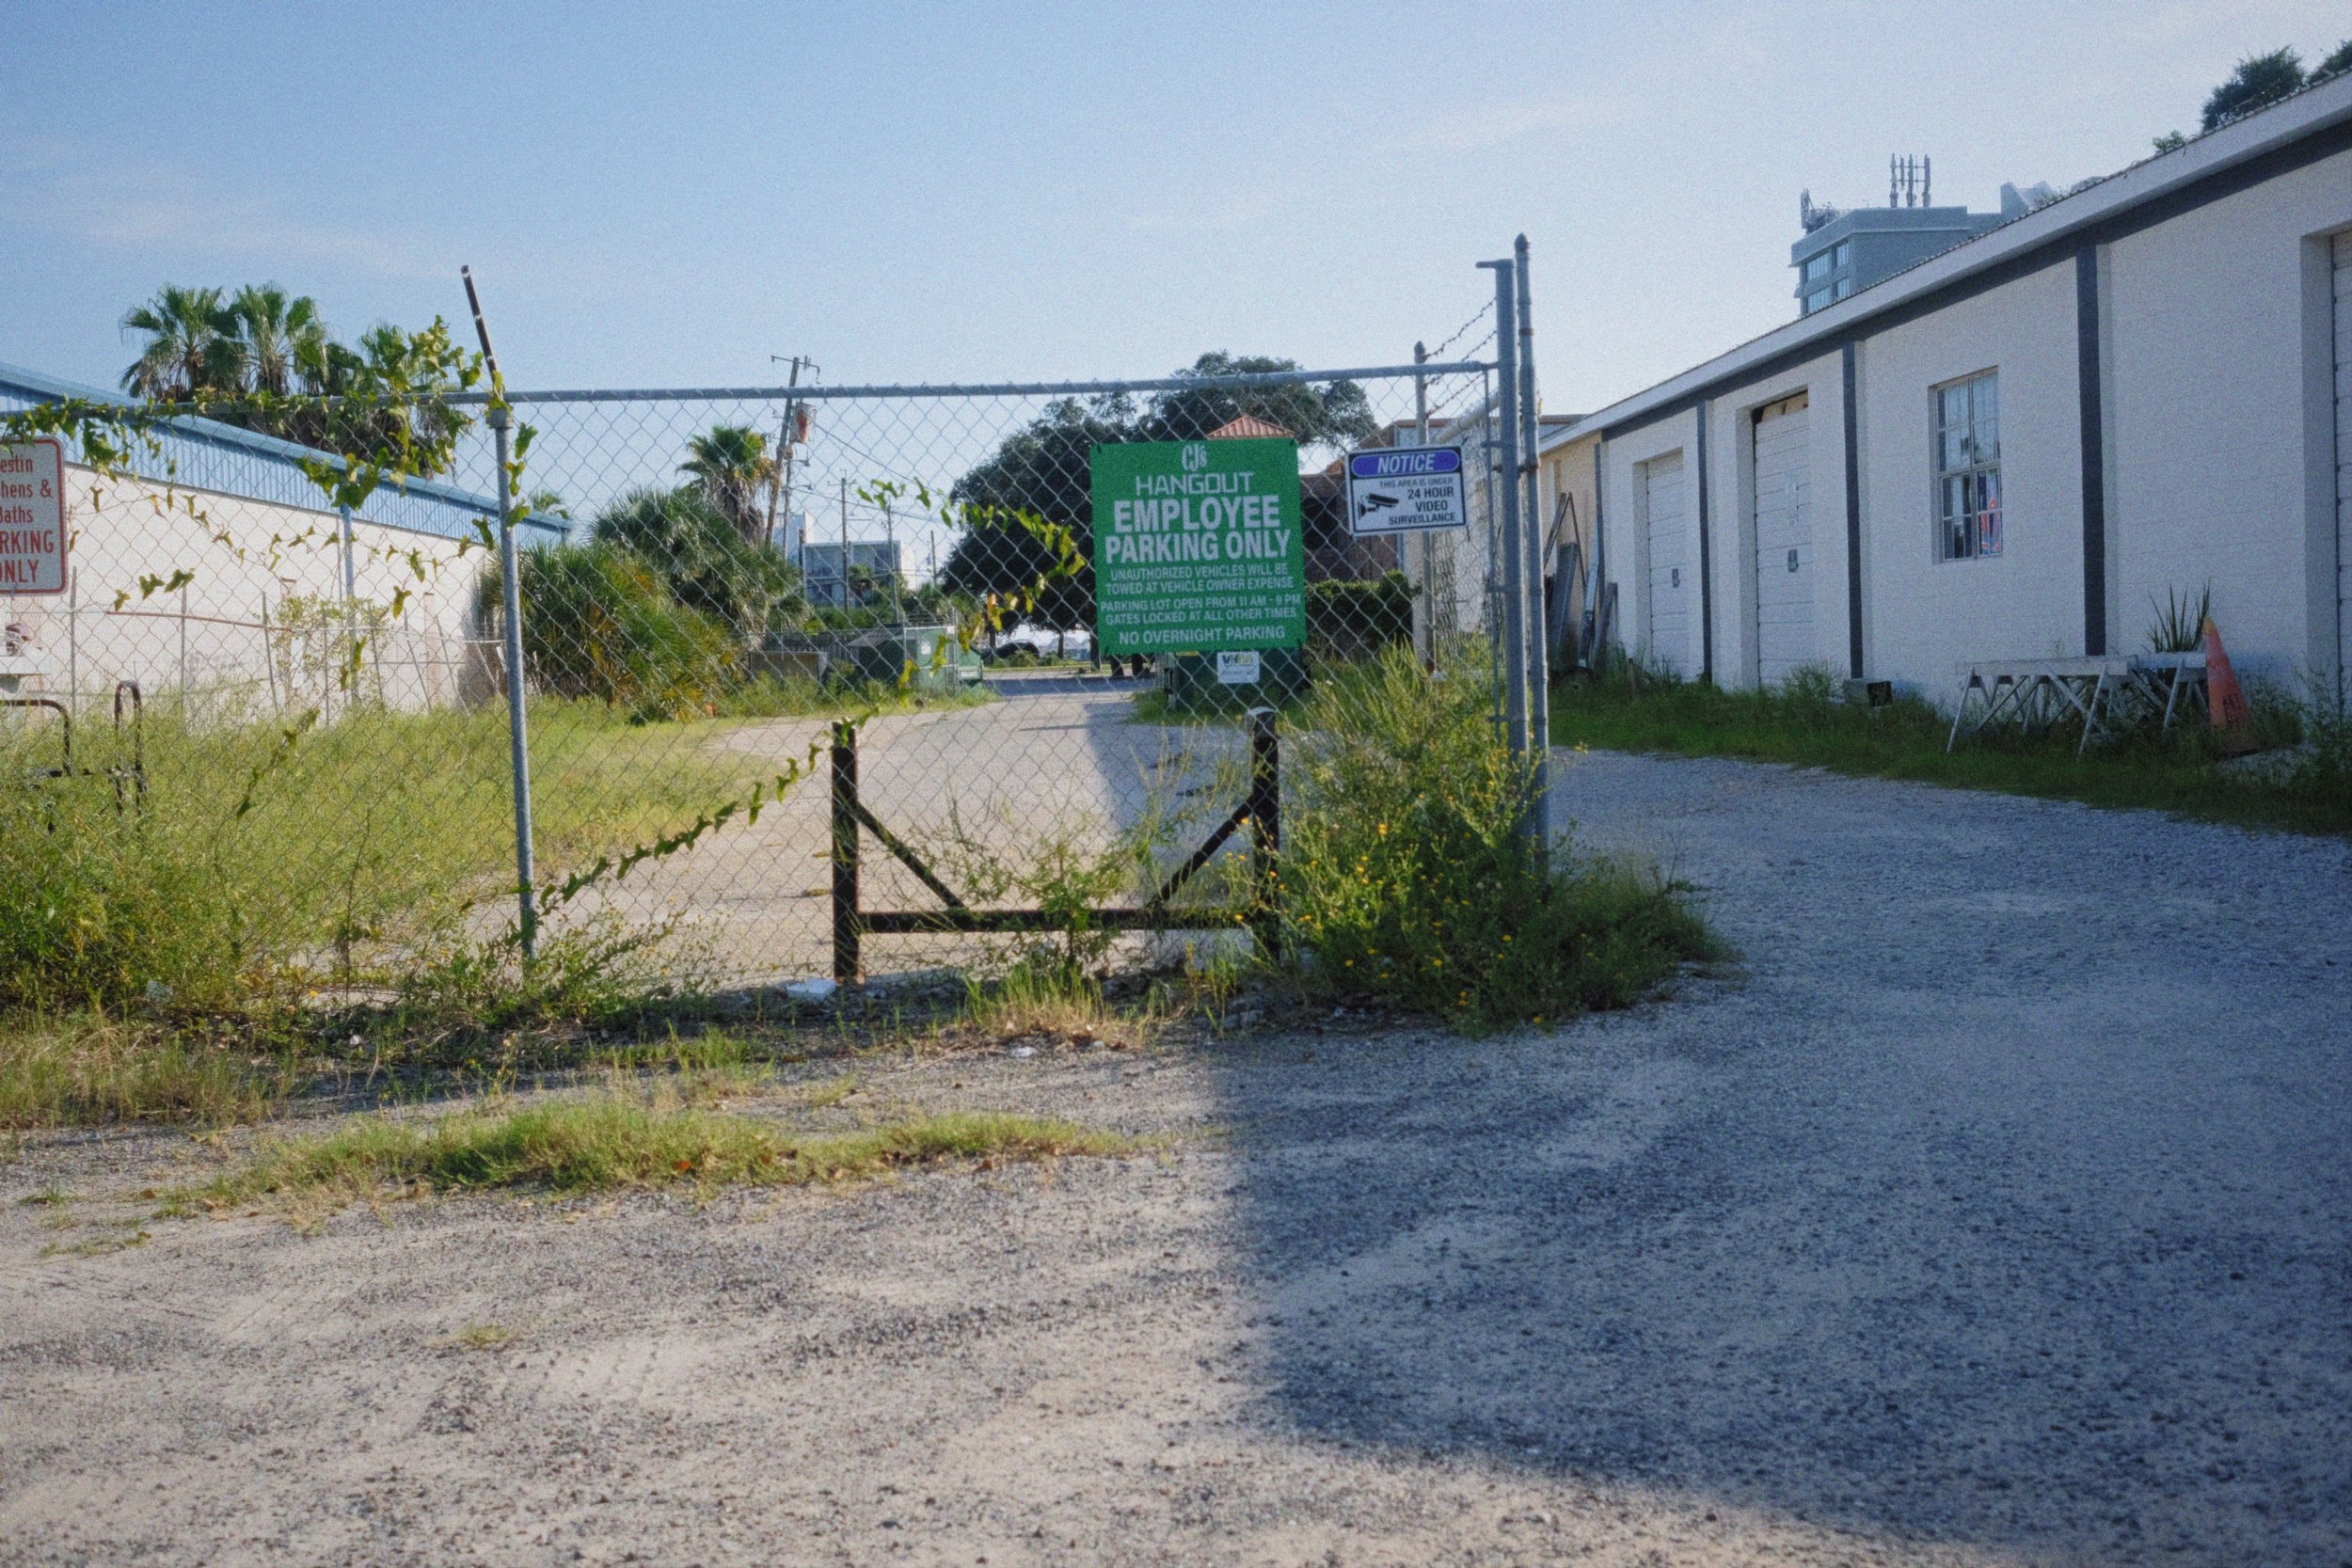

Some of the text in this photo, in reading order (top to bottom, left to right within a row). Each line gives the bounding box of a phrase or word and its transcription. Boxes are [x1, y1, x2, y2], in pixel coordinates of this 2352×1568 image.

[1377, 453, 1435, 474] NOTICE
[40, 479, 52, 498] &
[1136, 472, 1255, 496] HANGOUT
[1428, 477, 1453, 485] UNDER
[1407, 486, 1454, 499] 24 HOUR
[0, 505, 33, 524] aths
[1114, 495, 1280, 532] EMPLOYEE
[1416, 500, 1448, 512] VIDEO
[1389, 513, 1455, 525] SURVEILLANCE
[1105, 529, 1291, 563] PARKING ONLY
[0, 559, 39, 583] NLY
[1110, 562, 1288, 581] UNAUTHORIZED VEHICLES WILL BE
[1106, 577, 1294, 595] TOWED AT VEHICLE OWNER EXPENSE
[1101, 600, 1147, 612] PARKING
[1150, 599, 1170, 610] LOT
[1174, 597, 1202, 610] OPEN
[1205, 595, 1236, 609] FROM
[1250, 595, 1265, 607] AM
[1284, 594, 1300, 604] PM
[1105, 607, 1296, 626] GATES LOCKED AT ALL OTHER TIMES
[1119, 626, 1285, 645] NO OVERNIGHT PARKING
